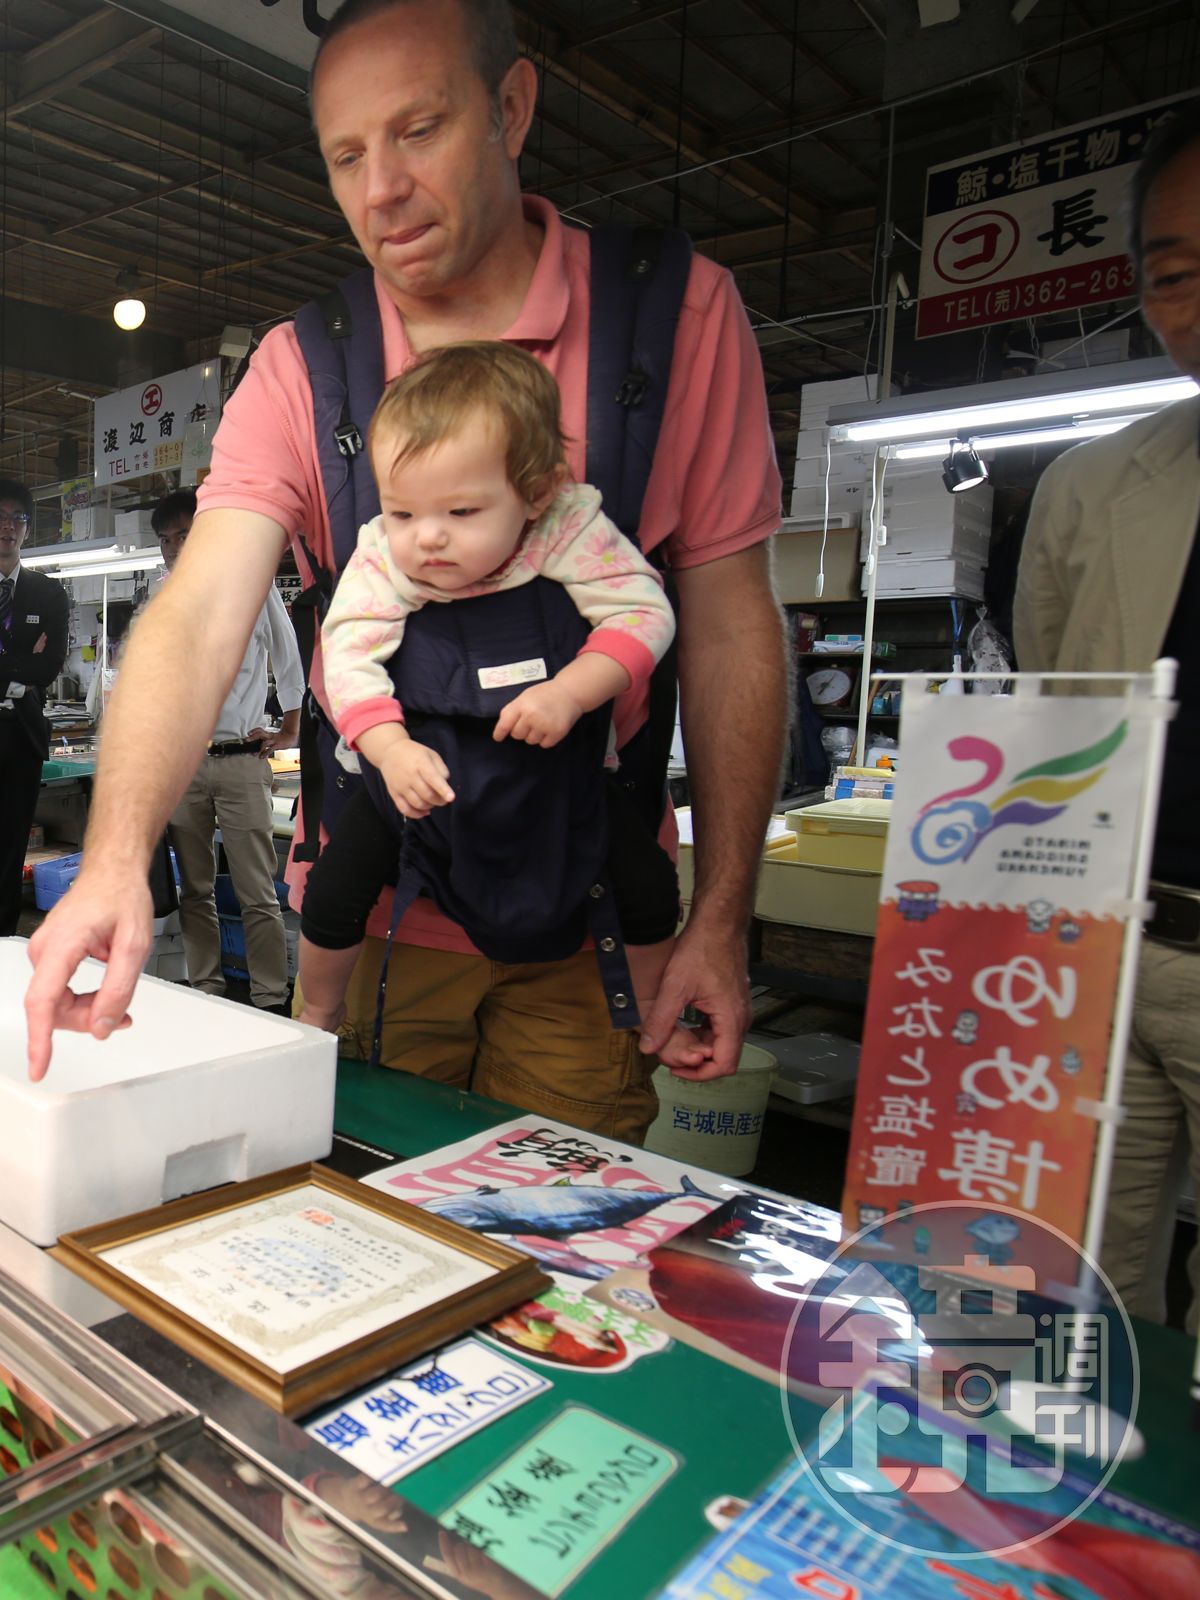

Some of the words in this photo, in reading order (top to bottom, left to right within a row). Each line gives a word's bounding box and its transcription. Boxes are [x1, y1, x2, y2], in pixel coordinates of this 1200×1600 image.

[956, 110, 1178, 206] 鯨・塩干物・
[1037, 188, 1109, 257] 長
[109, 457, 131, 477] TEL
